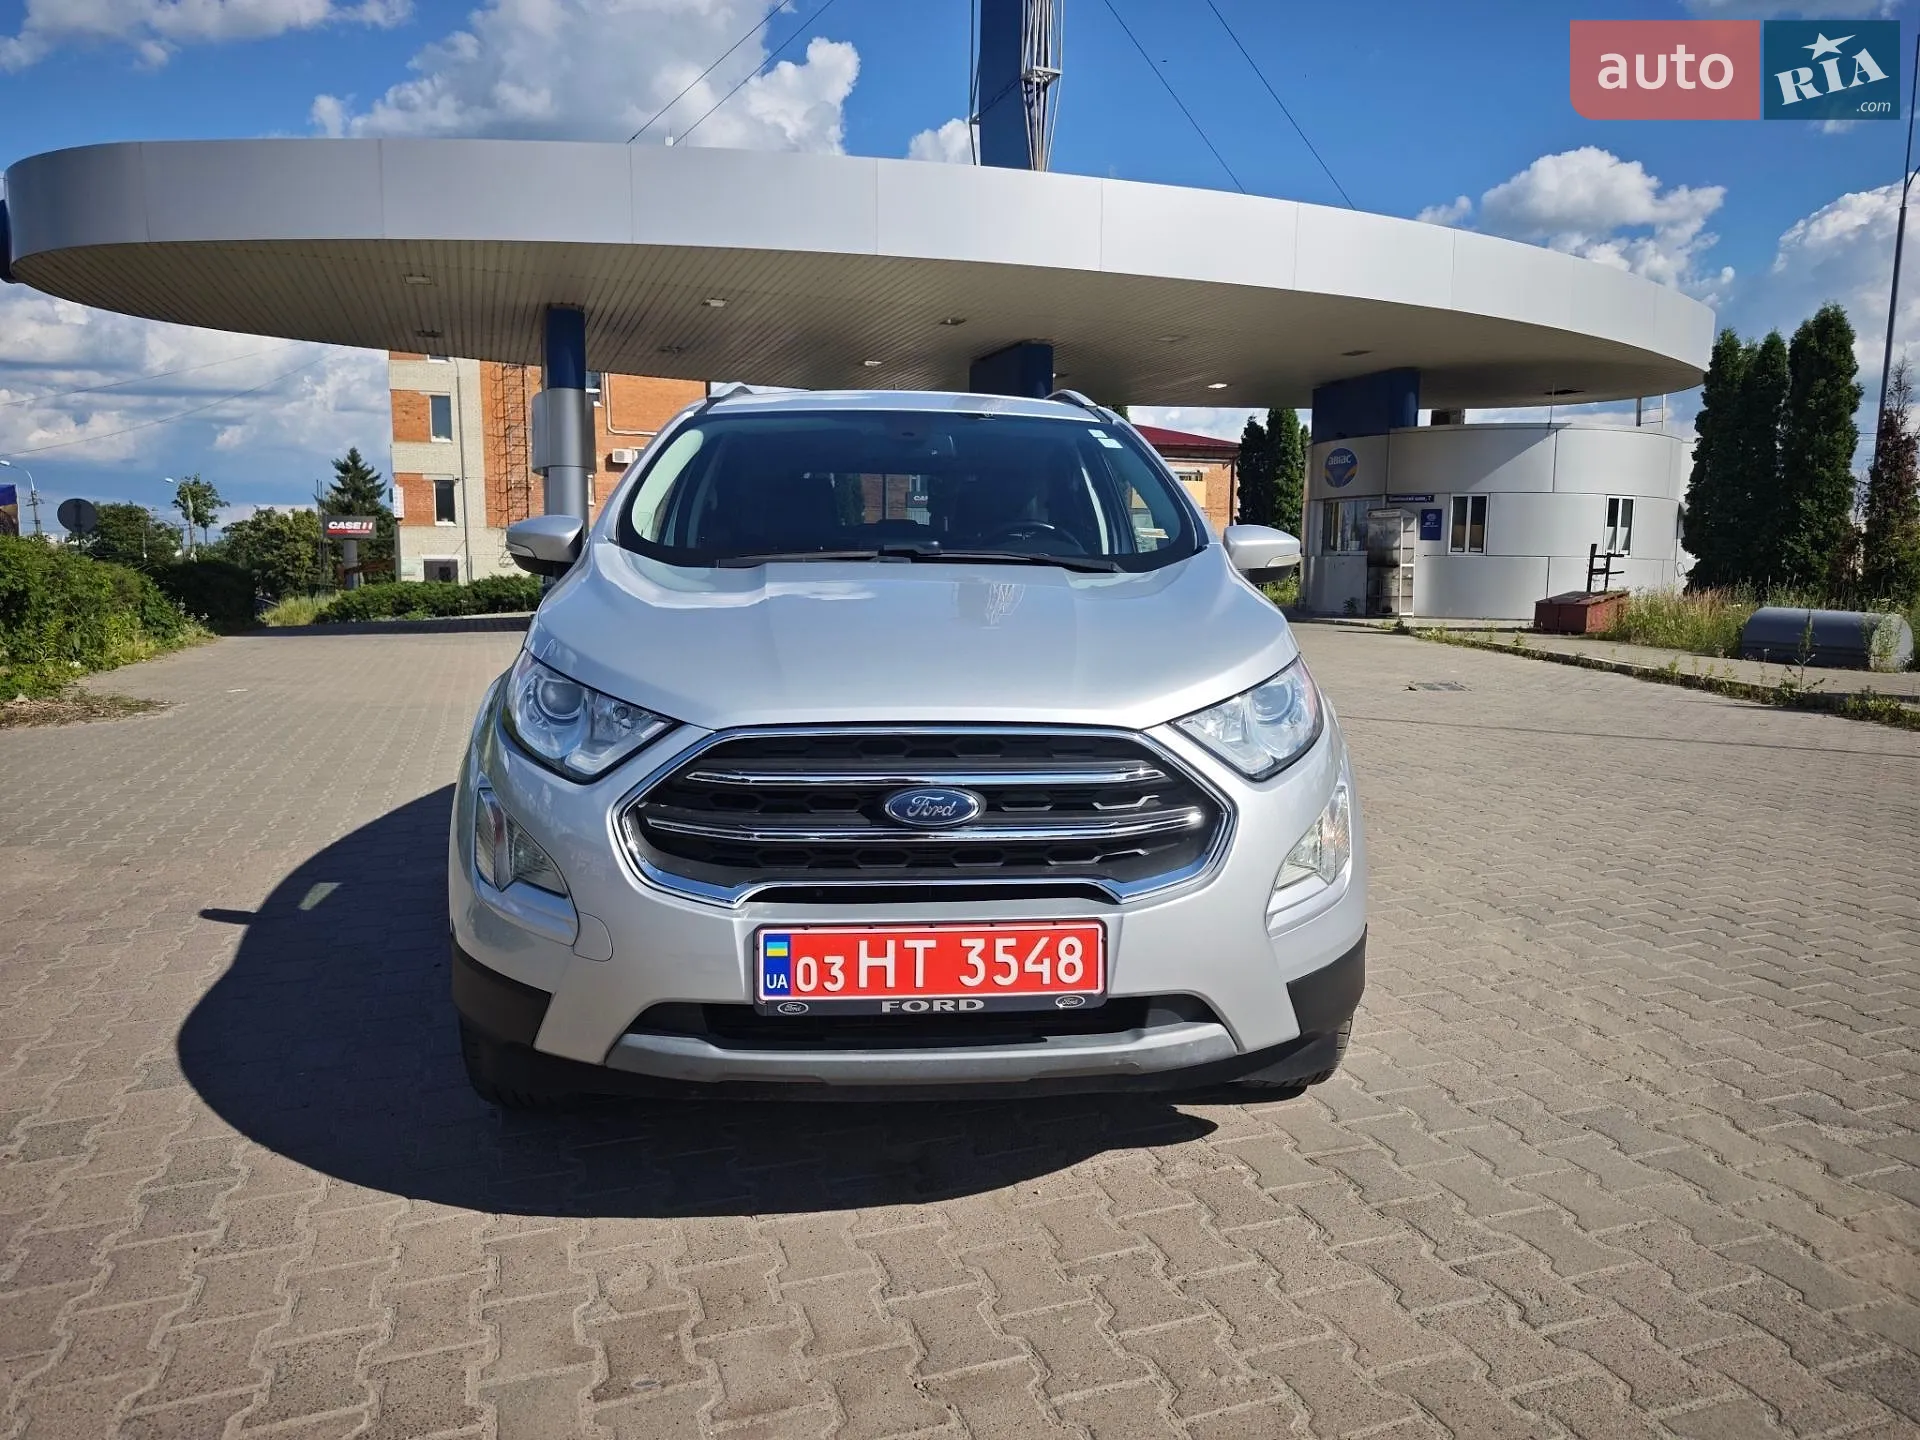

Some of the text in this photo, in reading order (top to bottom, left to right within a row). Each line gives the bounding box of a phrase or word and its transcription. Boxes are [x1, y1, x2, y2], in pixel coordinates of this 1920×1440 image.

[328, 521, 361, 530] CASE
[907, 795, 956, 816] Ford
[766, 936, 1084, 992] UA 03 HT 3548
[881, 1000, 985, 1013] FORD
